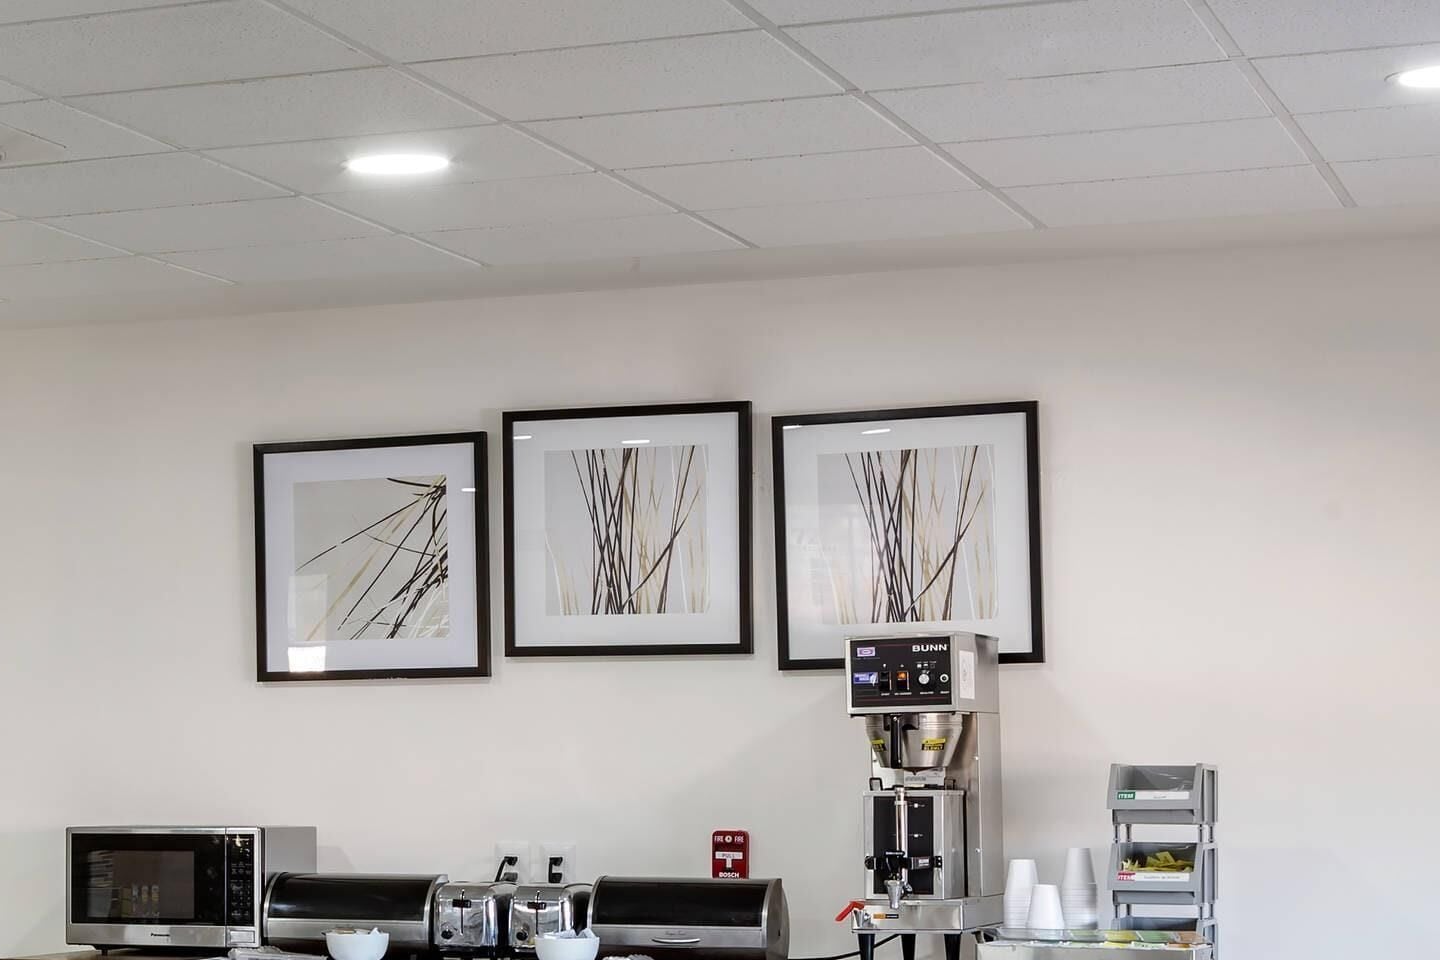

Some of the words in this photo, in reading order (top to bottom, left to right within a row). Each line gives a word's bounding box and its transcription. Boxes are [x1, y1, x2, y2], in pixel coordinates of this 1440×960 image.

[912, 644, 947, 652] BUNN
[714, 835, 724, 843] FIRE
[734, 835, 744, 843] FIRE
